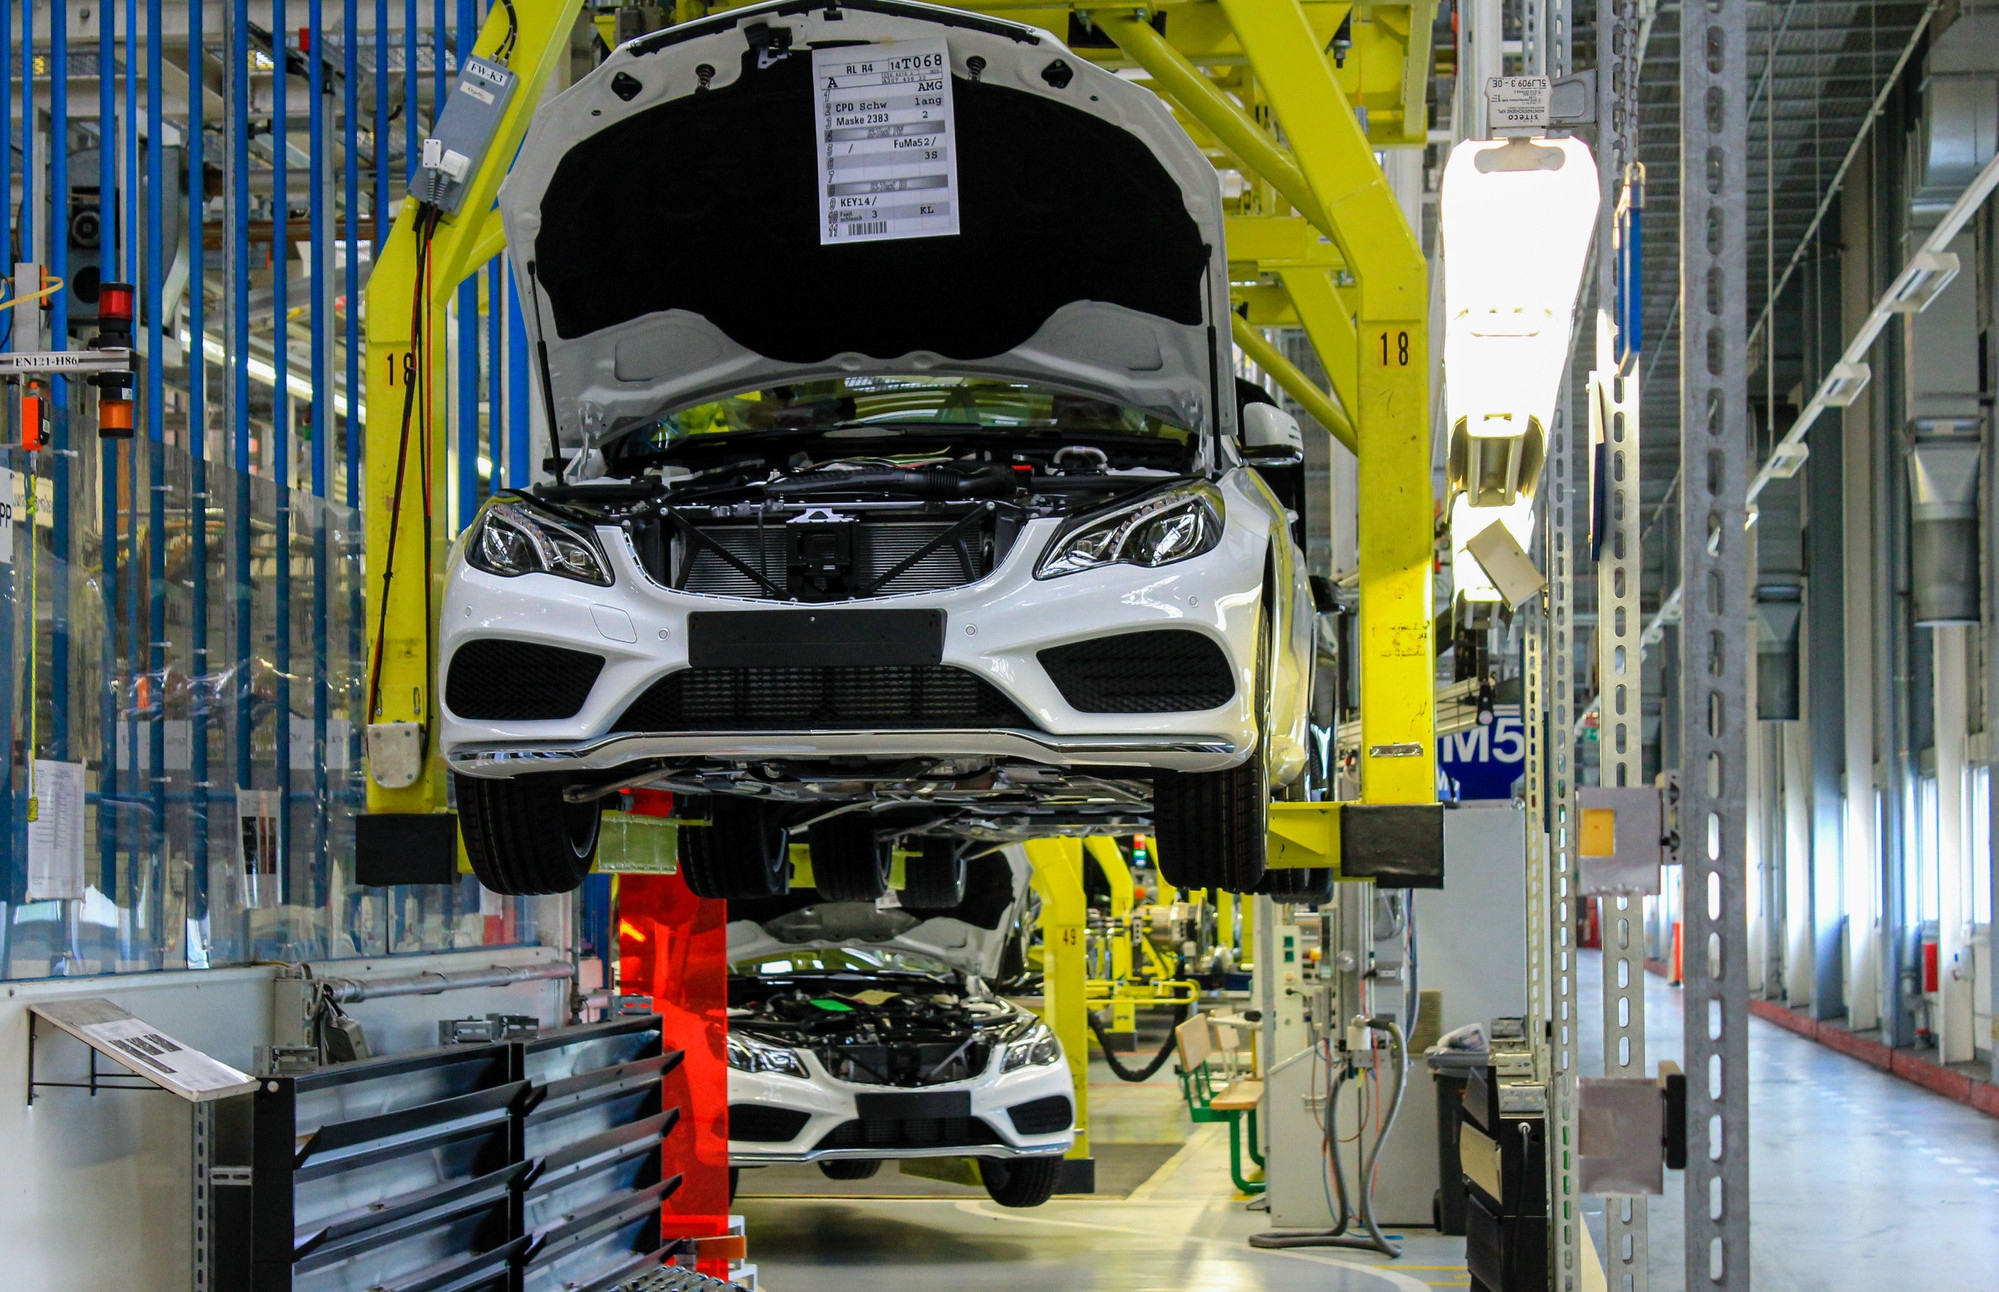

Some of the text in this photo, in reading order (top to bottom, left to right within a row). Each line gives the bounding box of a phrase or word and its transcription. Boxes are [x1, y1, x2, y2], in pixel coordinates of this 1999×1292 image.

[846, 64, 873, 75] RL R4
[827, 77, 839, 89] A
[917, 81, 943, 92] AMG
[835, 103, 854, 112] CPD
[860, 101, 887, 111] Schw
[915, 97, 942, 107] lang
[836, 116, 865, 126] Maske
[867, 114, 889, 123] 2383
[922, 110, 928, 119] 2
[924, 151, 938, 160] 3S
[872, 210, 878, 219] 3
[920, 206, 934, 215] KL
[1380, 331, 1409, 366] 18
[15, 356, 78, 367] EN121-H86
